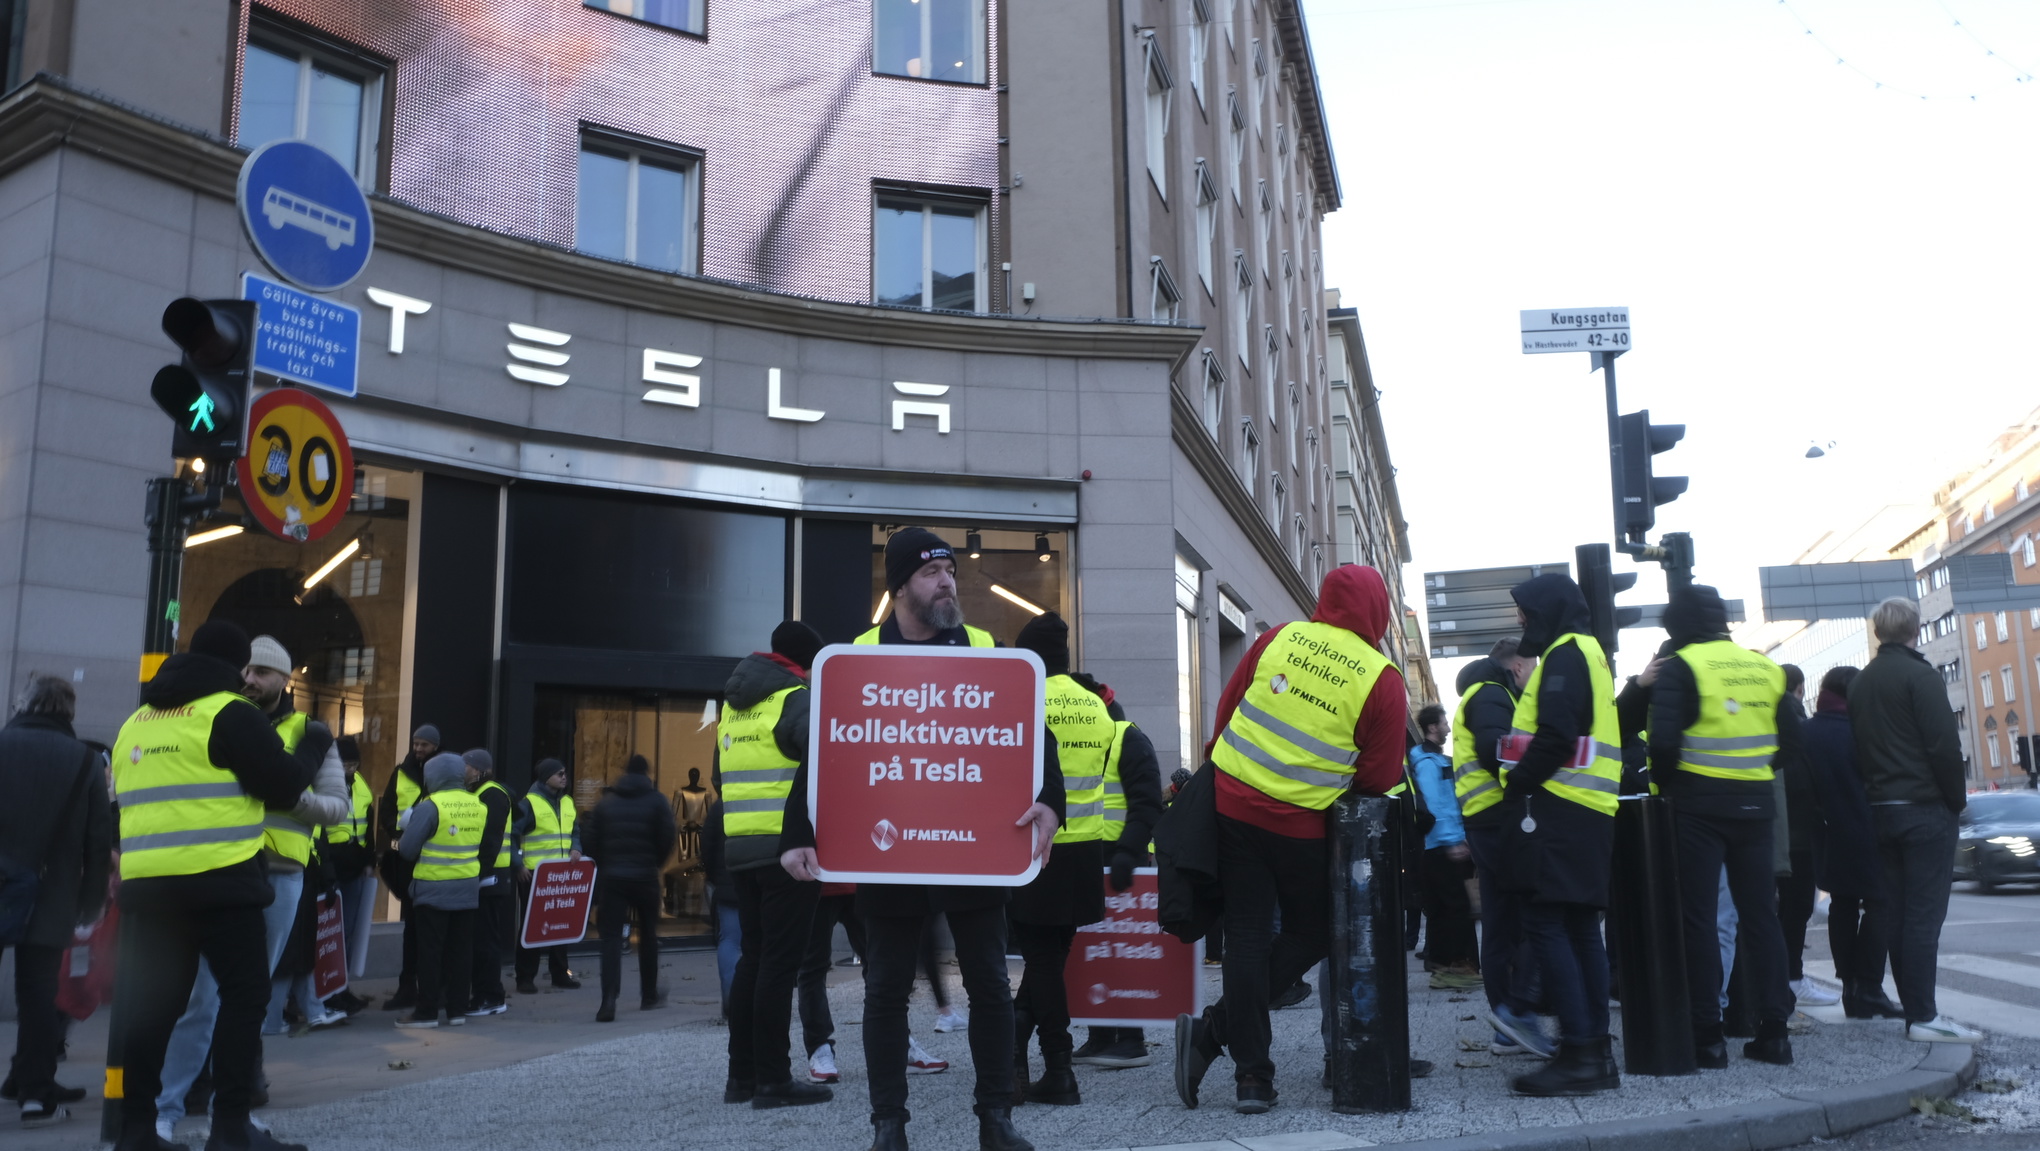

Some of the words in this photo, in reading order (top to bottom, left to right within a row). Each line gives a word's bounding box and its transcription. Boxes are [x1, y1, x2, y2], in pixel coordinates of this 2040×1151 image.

[262, 284, 306, 310] Gäller
[311, 301, 344, 324] även
[282, 307, 315, 330] buss
[319, 318, 324, 333] i
[1550, 312, 1627, 327] Kungsgatan
[266, 336, 306, 360] trafik
[311, 351, 335, 368] och
[1587, 332, 1629, 347] 42-40
[287, 359, 315, 378] taxi
[367, 286, 951, 434] TESLA
[257, 424, 338, 507] 30
[1288, 631, 1367, 676] Strejkande
[1286, 652, 1349, 688] tekniker
[861, 683, 946, 713] Strejk
[952, 683, 995, 709] för
[1045, 694, 1099, 709] trejkande
[1047, 711, 1097, 725] tekniker
[829, 717, 1024, 747] kollektivavtal
[868, 755, 904, 786] på
[910, 757, 983, 782] Tesla
[547, 871, 570, 883] Strejk
[571, 870, 583, 880] för
[535, 883, 589, 897] kollektivavtal
[1140, 892, 1158, 910] fö
[544, 897, 555, 912] på
[556, 897, 575, 909] Tesla
